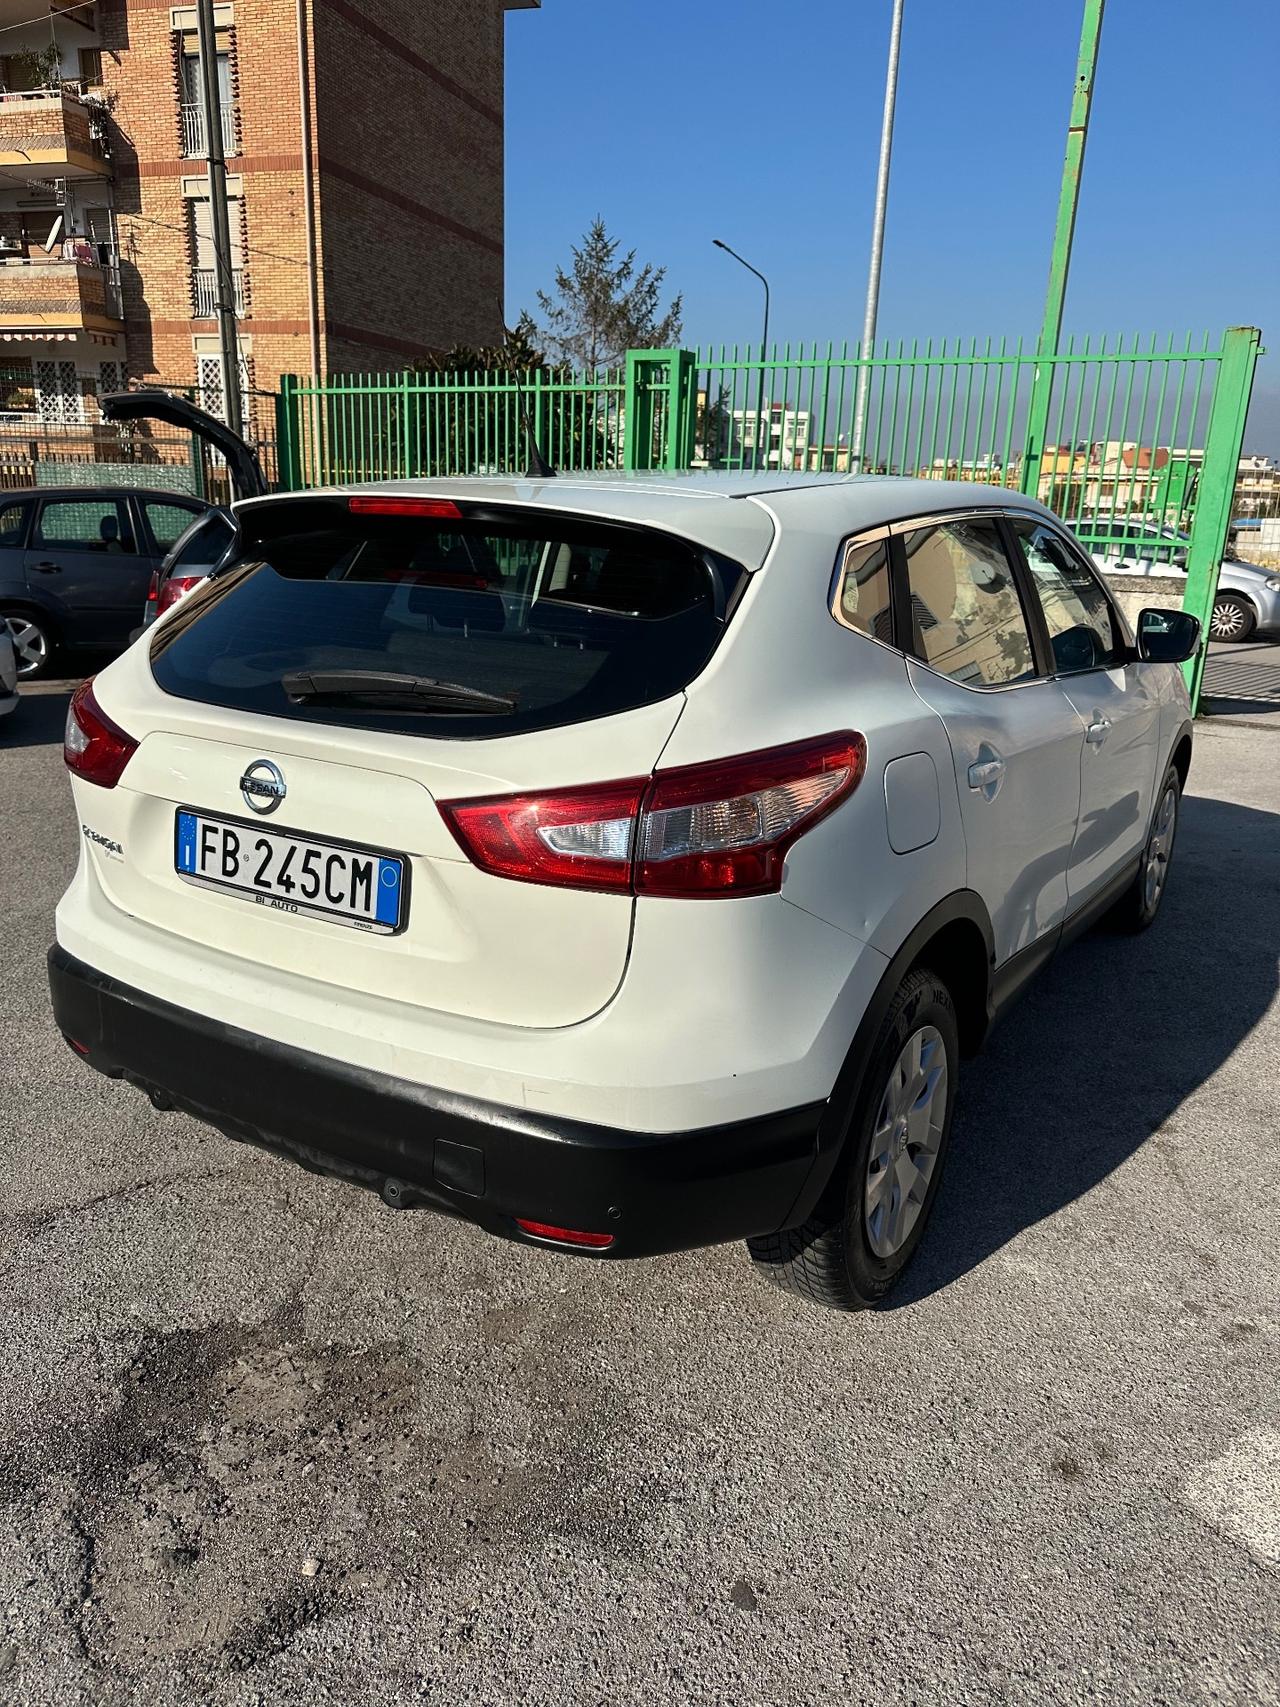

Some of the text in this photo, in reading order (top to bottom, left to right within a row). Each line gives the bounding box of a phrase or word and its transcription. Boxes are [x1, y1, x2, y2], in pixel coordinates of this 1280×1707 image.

[242, 779, 279, 796] SSAN
[201, 823, 240, 878] FB
[254, 838, 373, 912] 245CM
[255, 895, 298, 913] BI AUTO
